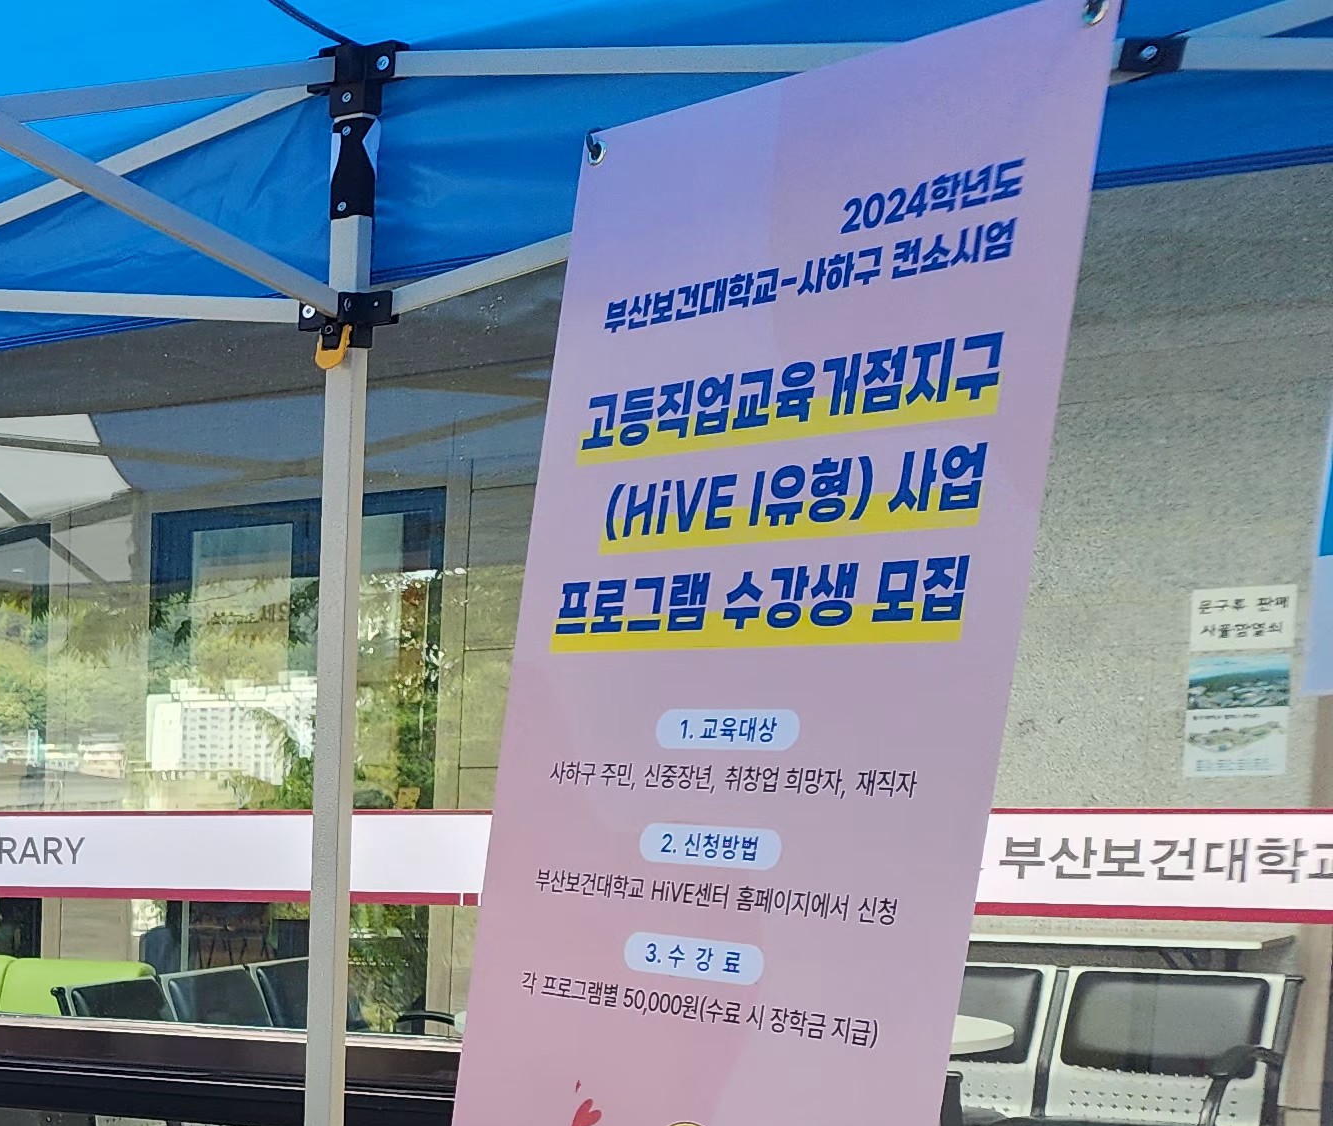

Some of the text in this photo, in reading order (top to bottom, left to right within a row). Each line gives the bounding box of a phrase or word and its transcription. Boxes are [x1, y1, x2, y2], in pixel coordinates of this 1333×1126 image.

[840, 158, 1026, 234] 2024학년도
[604, 217, 1018, 333] 부산보건대학교-사하구 컨소시엄
[581, 331, 1004, 451] 고등직업교육거점지구
[605, 473, 737, 541] (HiVE
[888, 442, 988, 513] 사업
[555, 555, 971, 635] 프로그램 수강생 모집
[680, 716, 778, 743] 1. 교육대상
[549, 761, 917, 799] 사하구 주민, 신중장년, 취창업 희망자, 재직자
[660, 833, 760, 862] 2. 신청방법
[534, 868, 898, 926] 부산보건대학교 HiVE센터 홈페이지에서 신청
[645, 943, 662, 964] 3.
[521, 971, 538, 995] 각
[541, 975, 619, 1008] 프로그램별
[746, 1005, 765, 1031] 시
[769, 1007, 827, 1041] 장학금
[831, 1016, 879, 1049] 지급)
